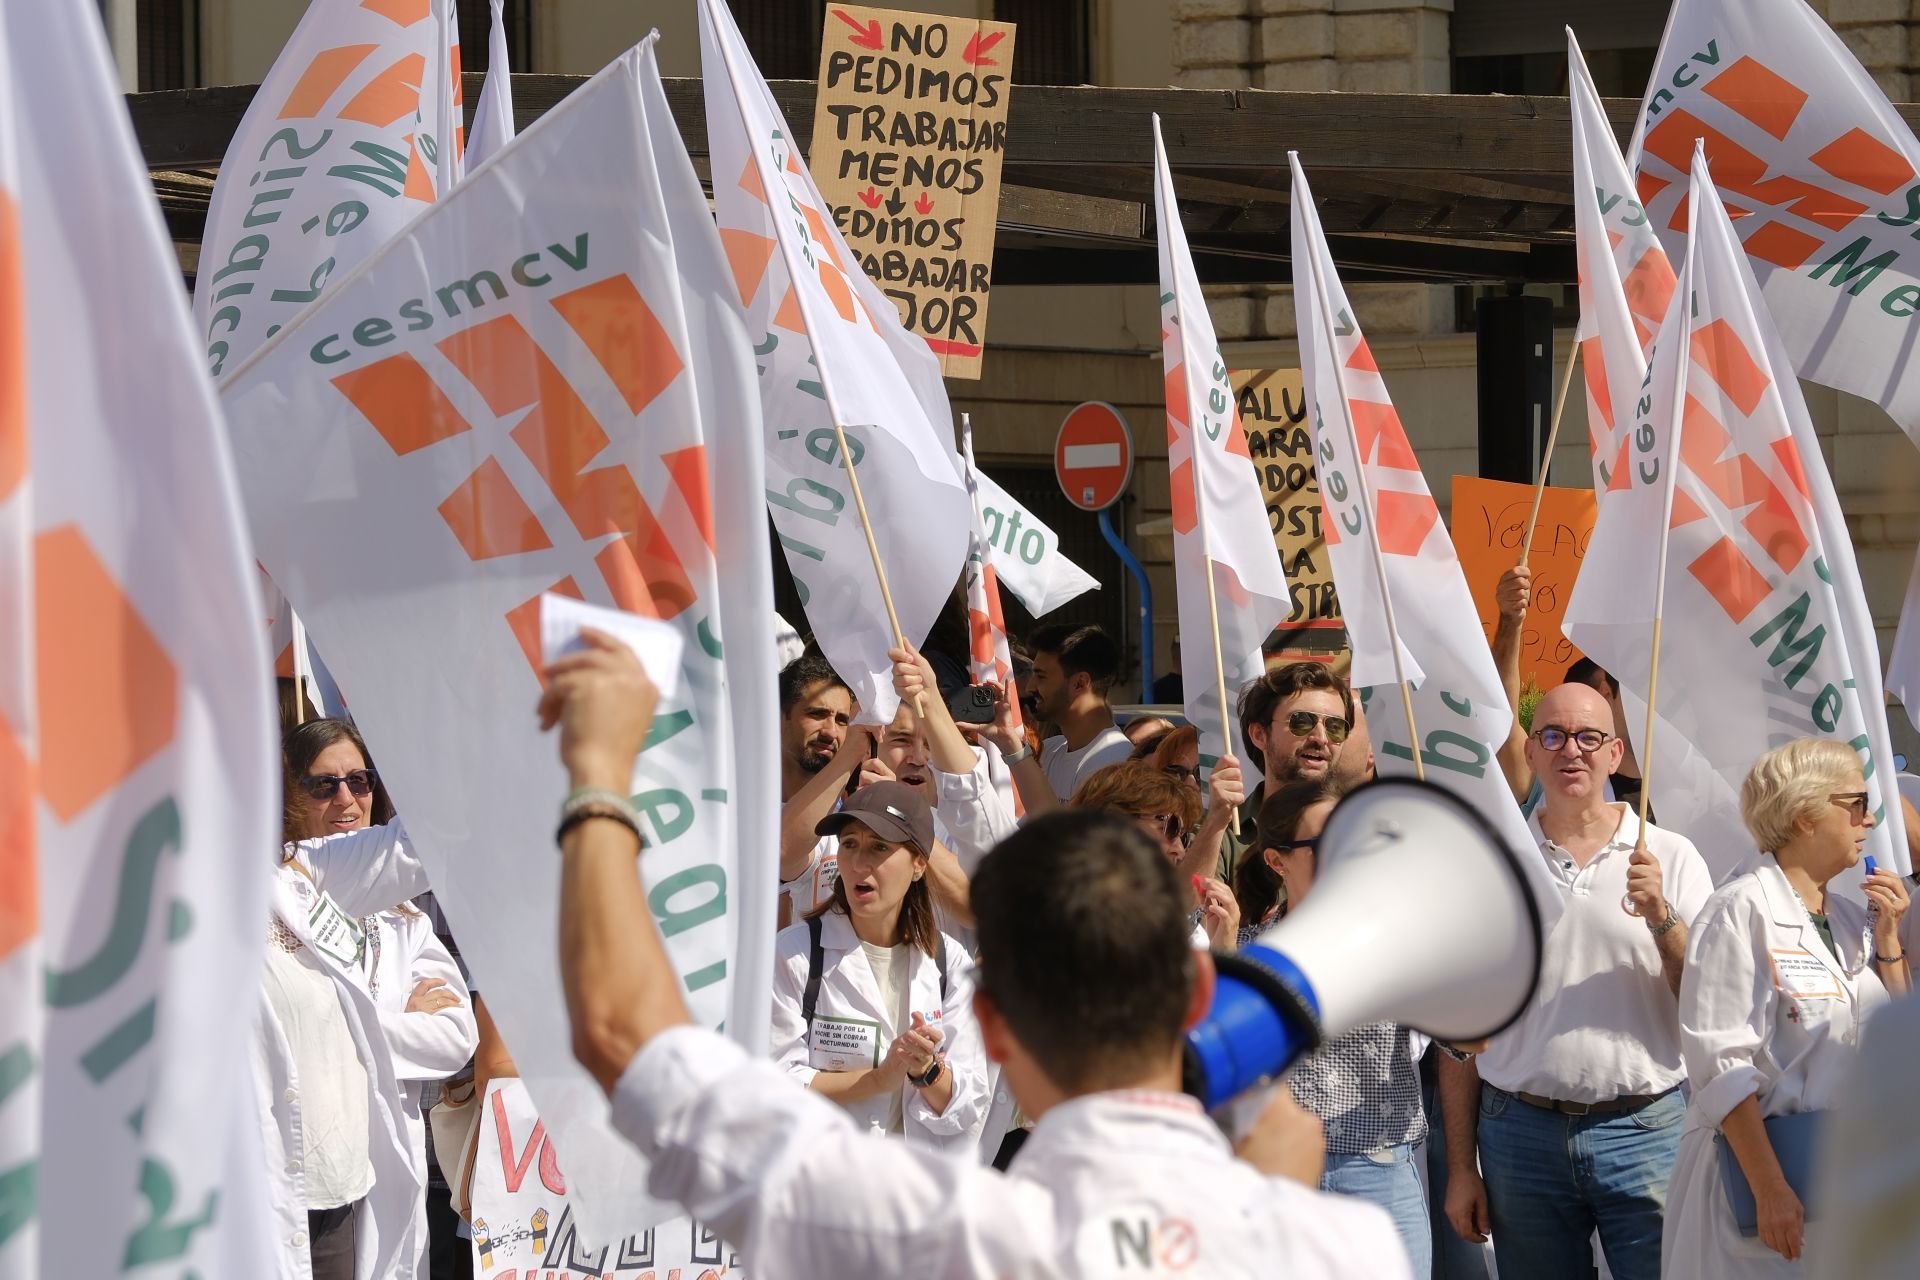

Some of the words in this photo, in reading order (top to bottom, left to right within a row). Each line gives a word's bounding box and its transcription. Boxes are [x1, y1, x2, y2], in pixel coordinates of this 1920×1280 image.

[891, 22, 948, 58] NO
[827, 51, 1004, 108] PEDIMOS
[827, 104, 1006, 153] TRABAJAR
[838, 149, 984, 195] MENOS
[309, 232, 590, 364] cesmcv
[815, 1030, 831, 1038] NOCHE
[817, 1022, 842, 1031] TRABAJO
[820, 1039, 859, 1048] NOCTURNIDAD
